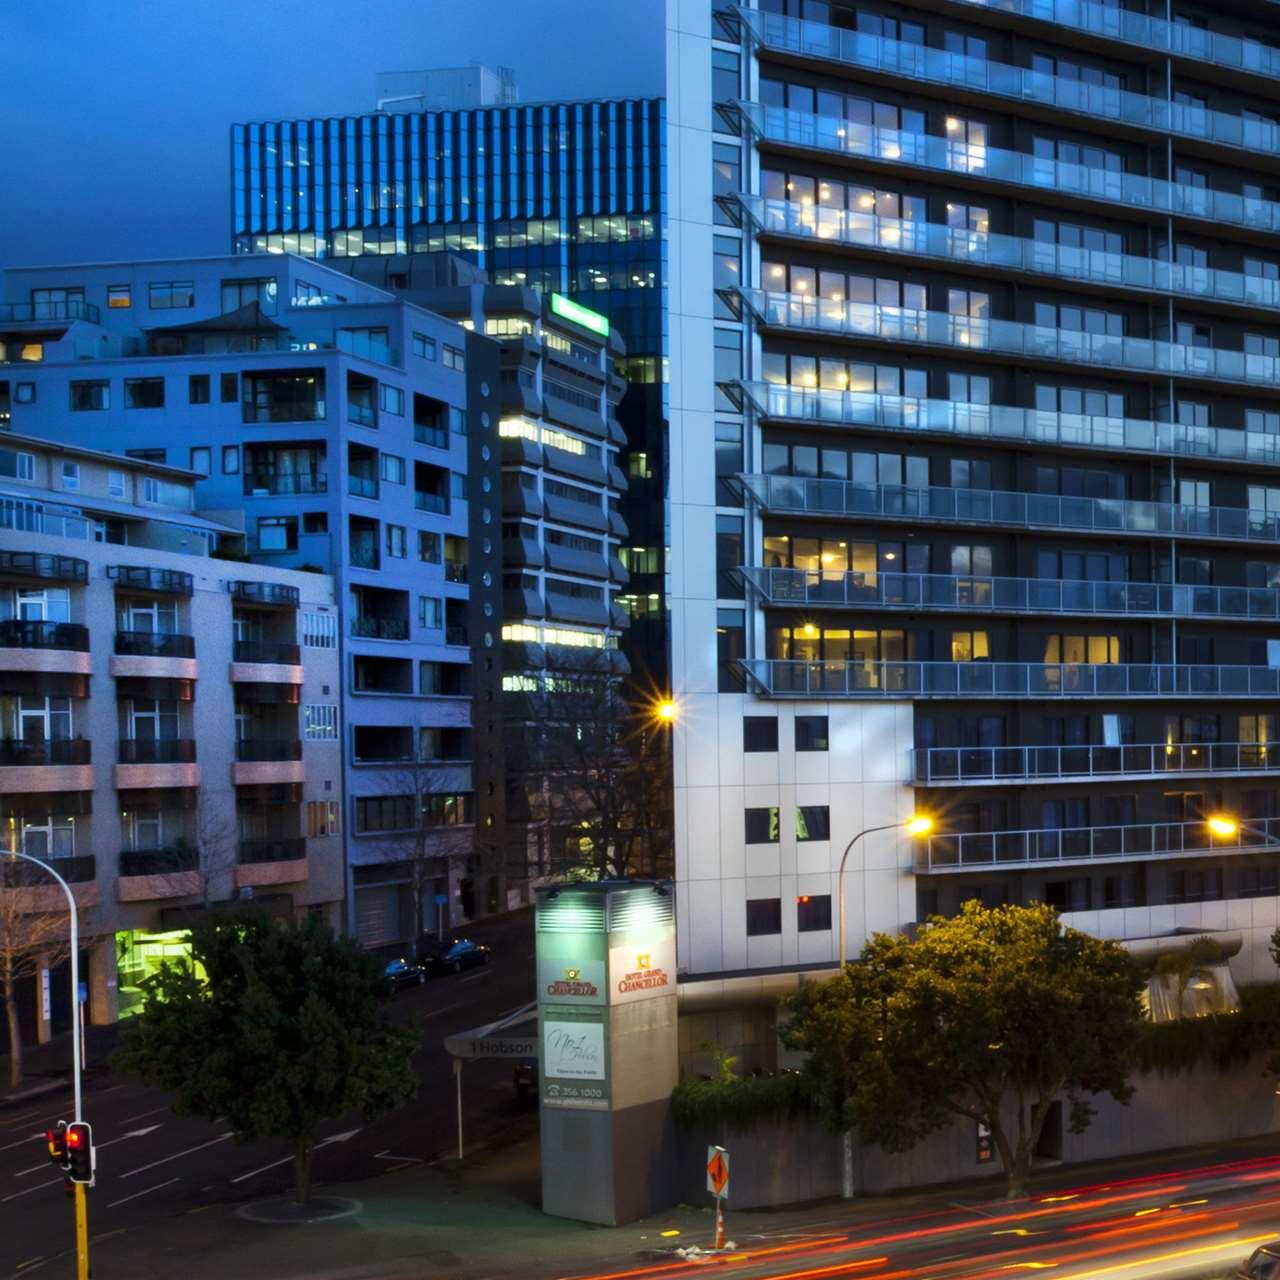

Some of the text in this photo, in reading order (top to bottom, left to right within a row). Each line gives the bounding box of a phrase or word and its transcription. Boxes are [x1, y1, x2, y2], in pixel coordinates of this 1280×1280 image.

[618, 973, 669, 993] CHANCELLOR
[480, 1039, 533, 1054] Hobson
[580, 1088, 602, 1098] 1000
